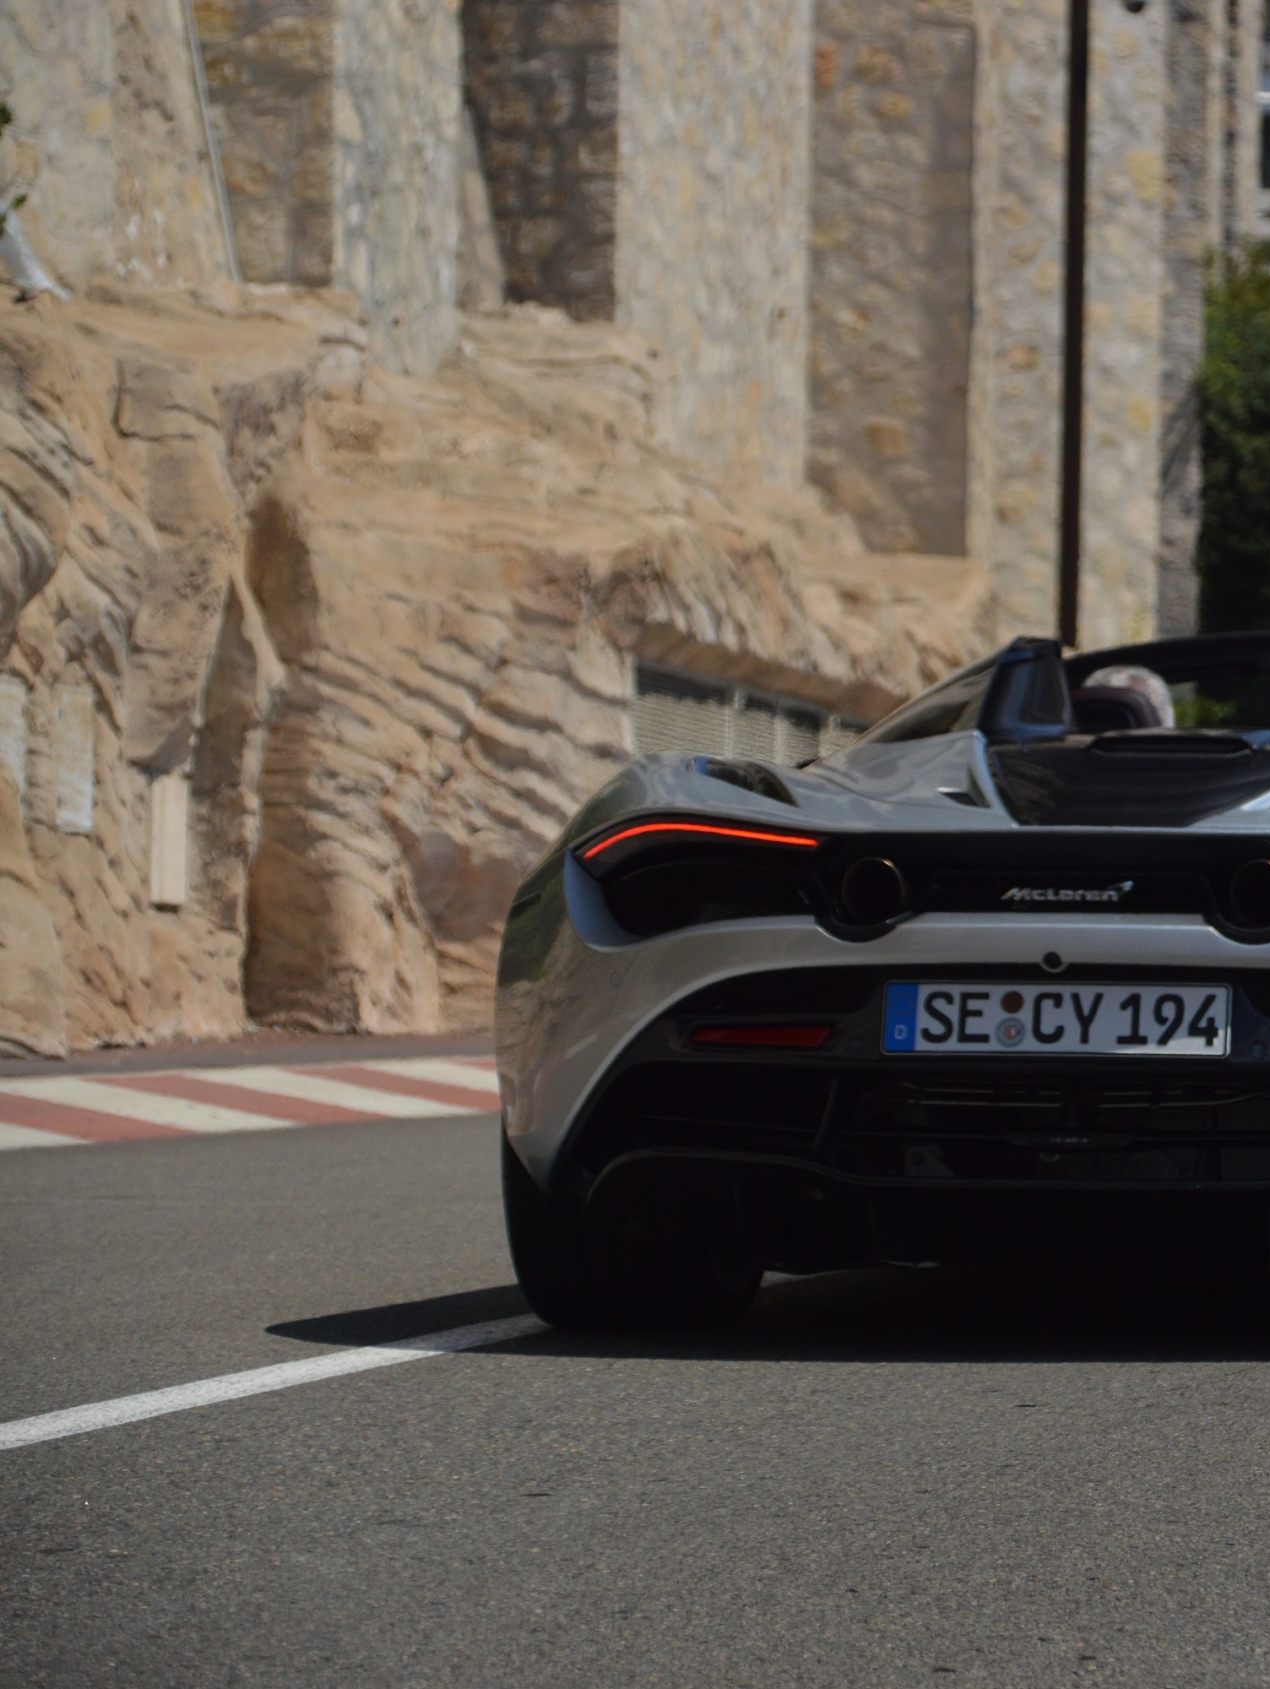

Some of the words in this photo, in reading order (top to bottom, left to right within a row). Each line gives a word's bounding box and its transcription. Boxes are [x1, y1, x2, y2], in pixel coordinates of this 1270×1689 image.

[1001, 887, 1118, 901] McLaren
[920, 991, 990, 1043] SE
[1032, 992, 1104, 1044] CY
[1116, 993, 1219, 1046] 194
[894, 1025, 908, 1040] D
